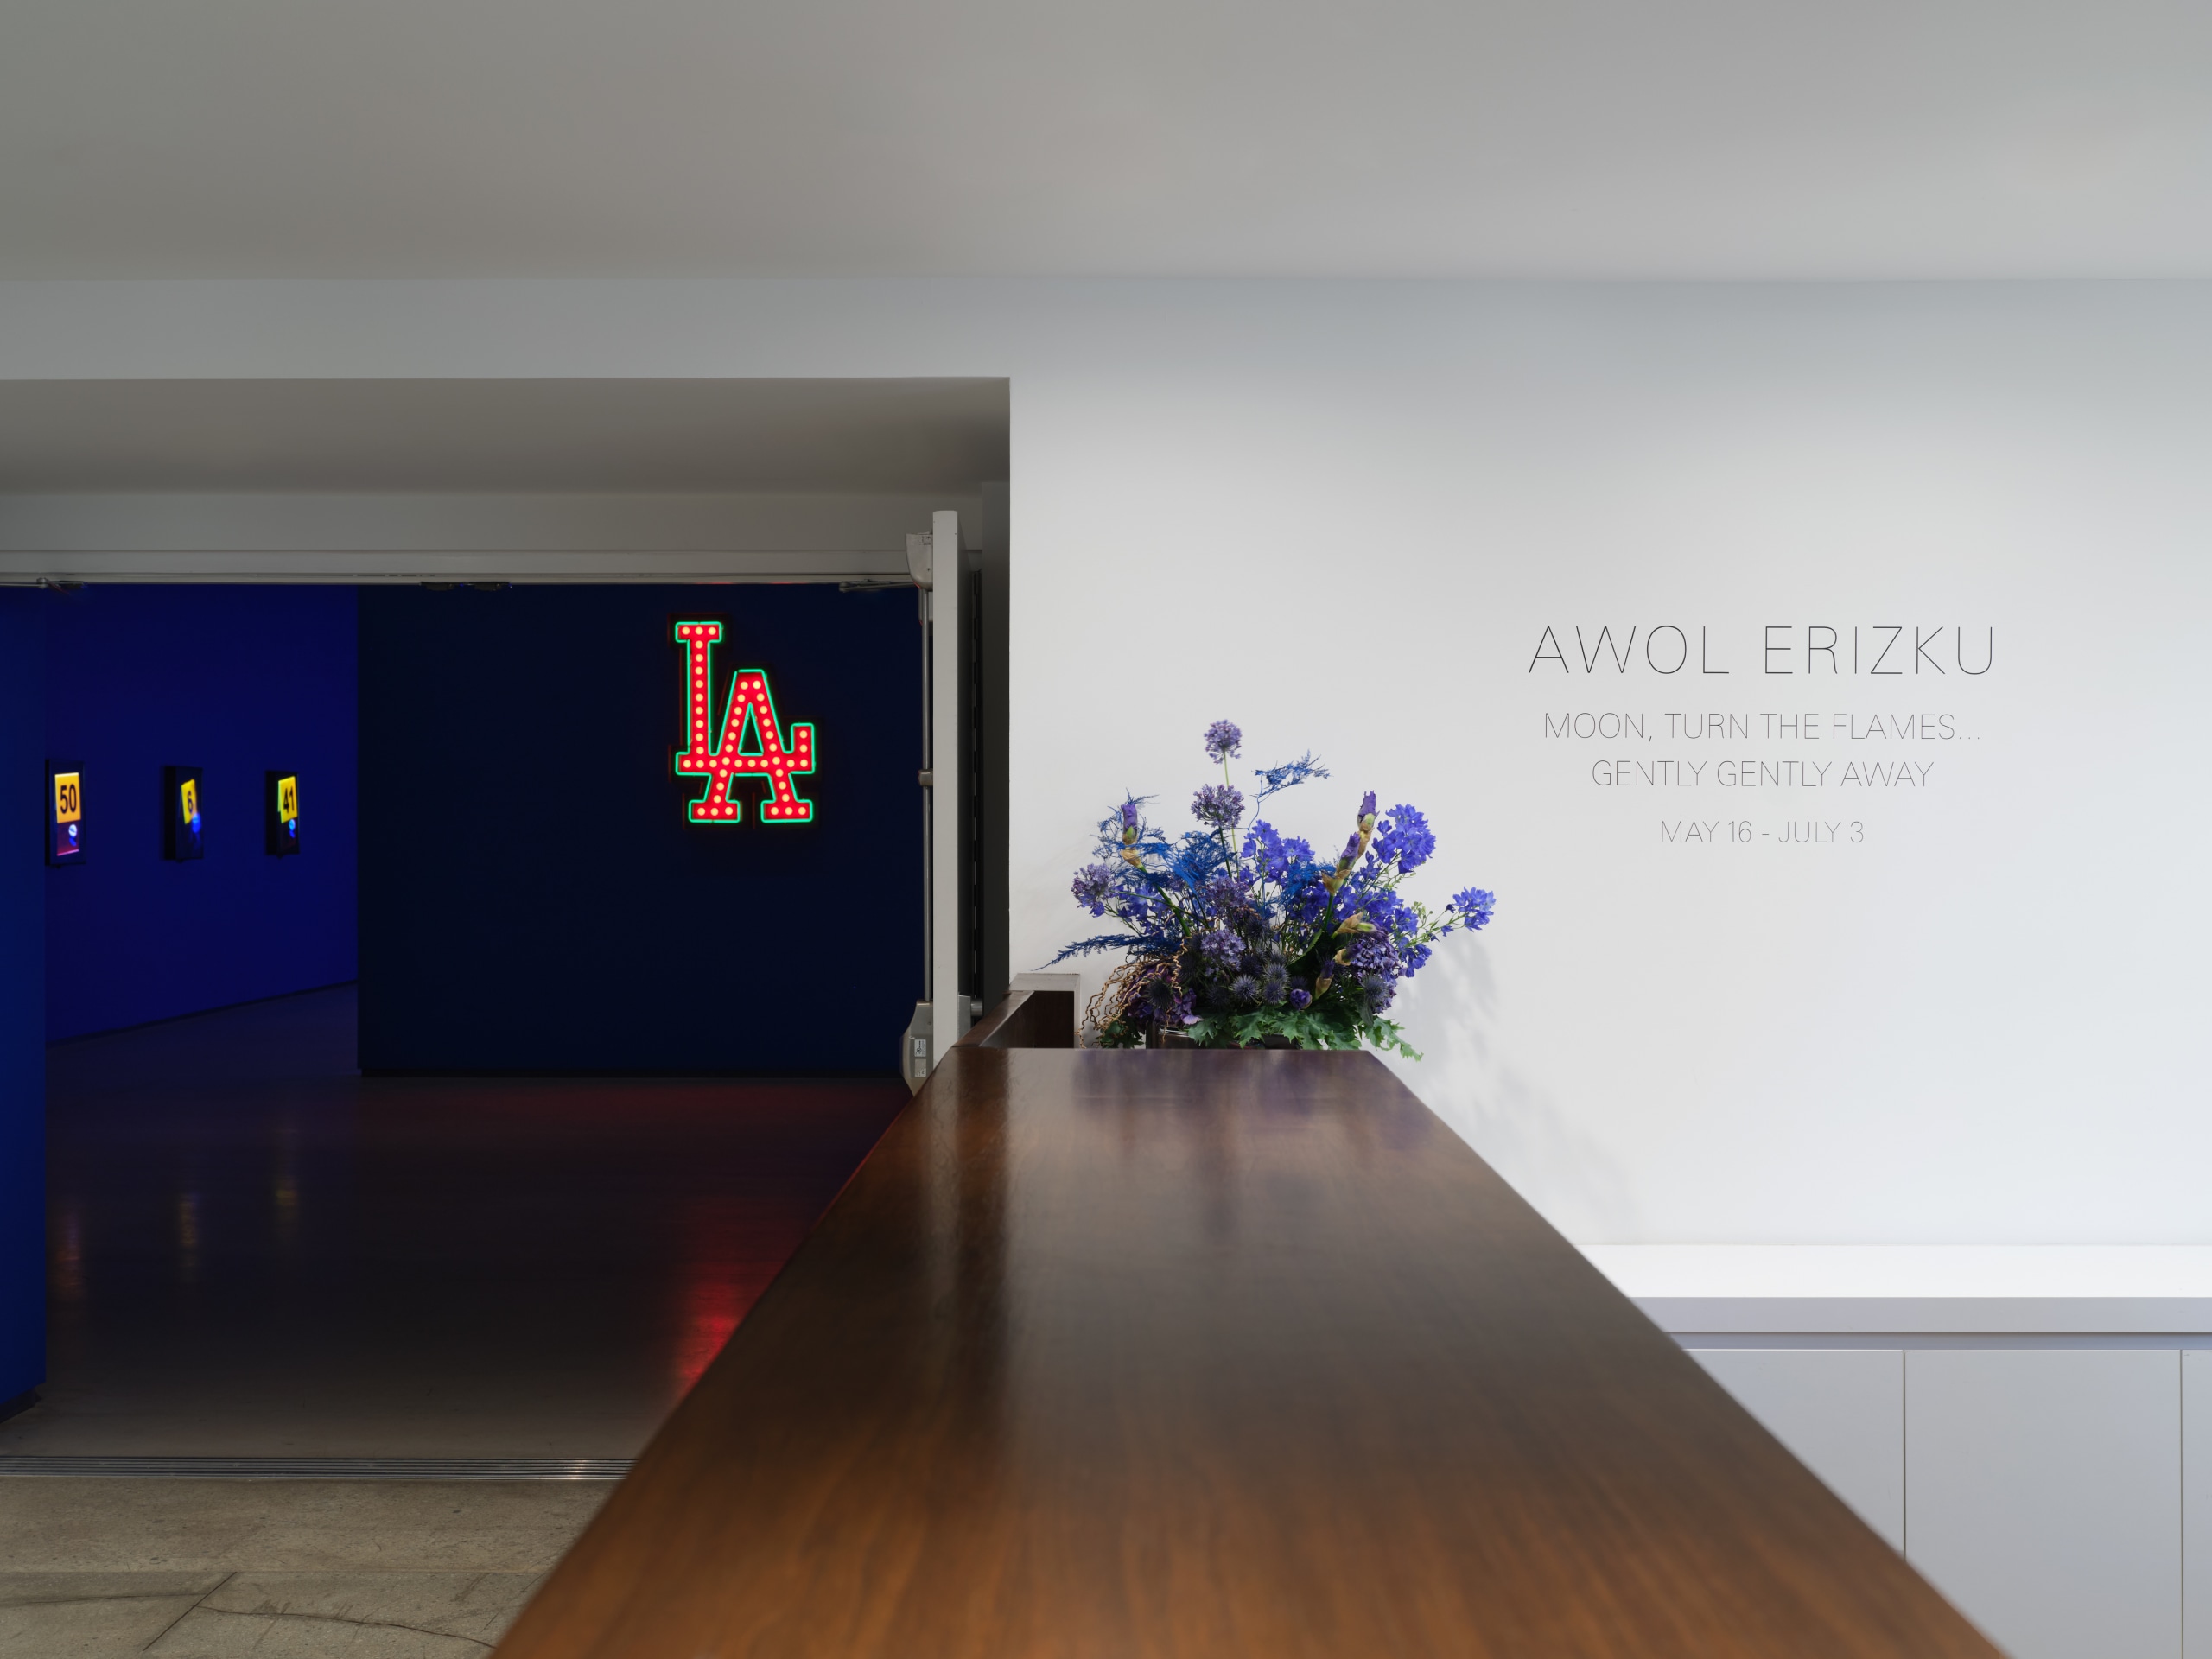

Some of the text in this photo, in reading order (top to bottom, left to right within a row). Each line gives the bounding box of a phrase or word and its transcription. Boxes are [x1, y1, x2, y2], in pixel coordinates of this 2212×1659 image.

[1528, 625, 1993, 676] AWOL ERIZKU
[675, 621, 815, 823] LA
[1544, 712, 1980, 743] MOON, TURN THE FLAMES...
[1592, 760, 1935, 788] GENTLY GENTLY AWAY
[60, 783, 77, 815] 50
[187, 790, 194, 815] 6
[283, 785, 295, 814] 41
[1661, 820, 1719, 843] MAY
[1727, 820, 1752, 843] 16
[1777, 821, 1842, 843] JULY
[1850, 820, 1865, 843] 3
